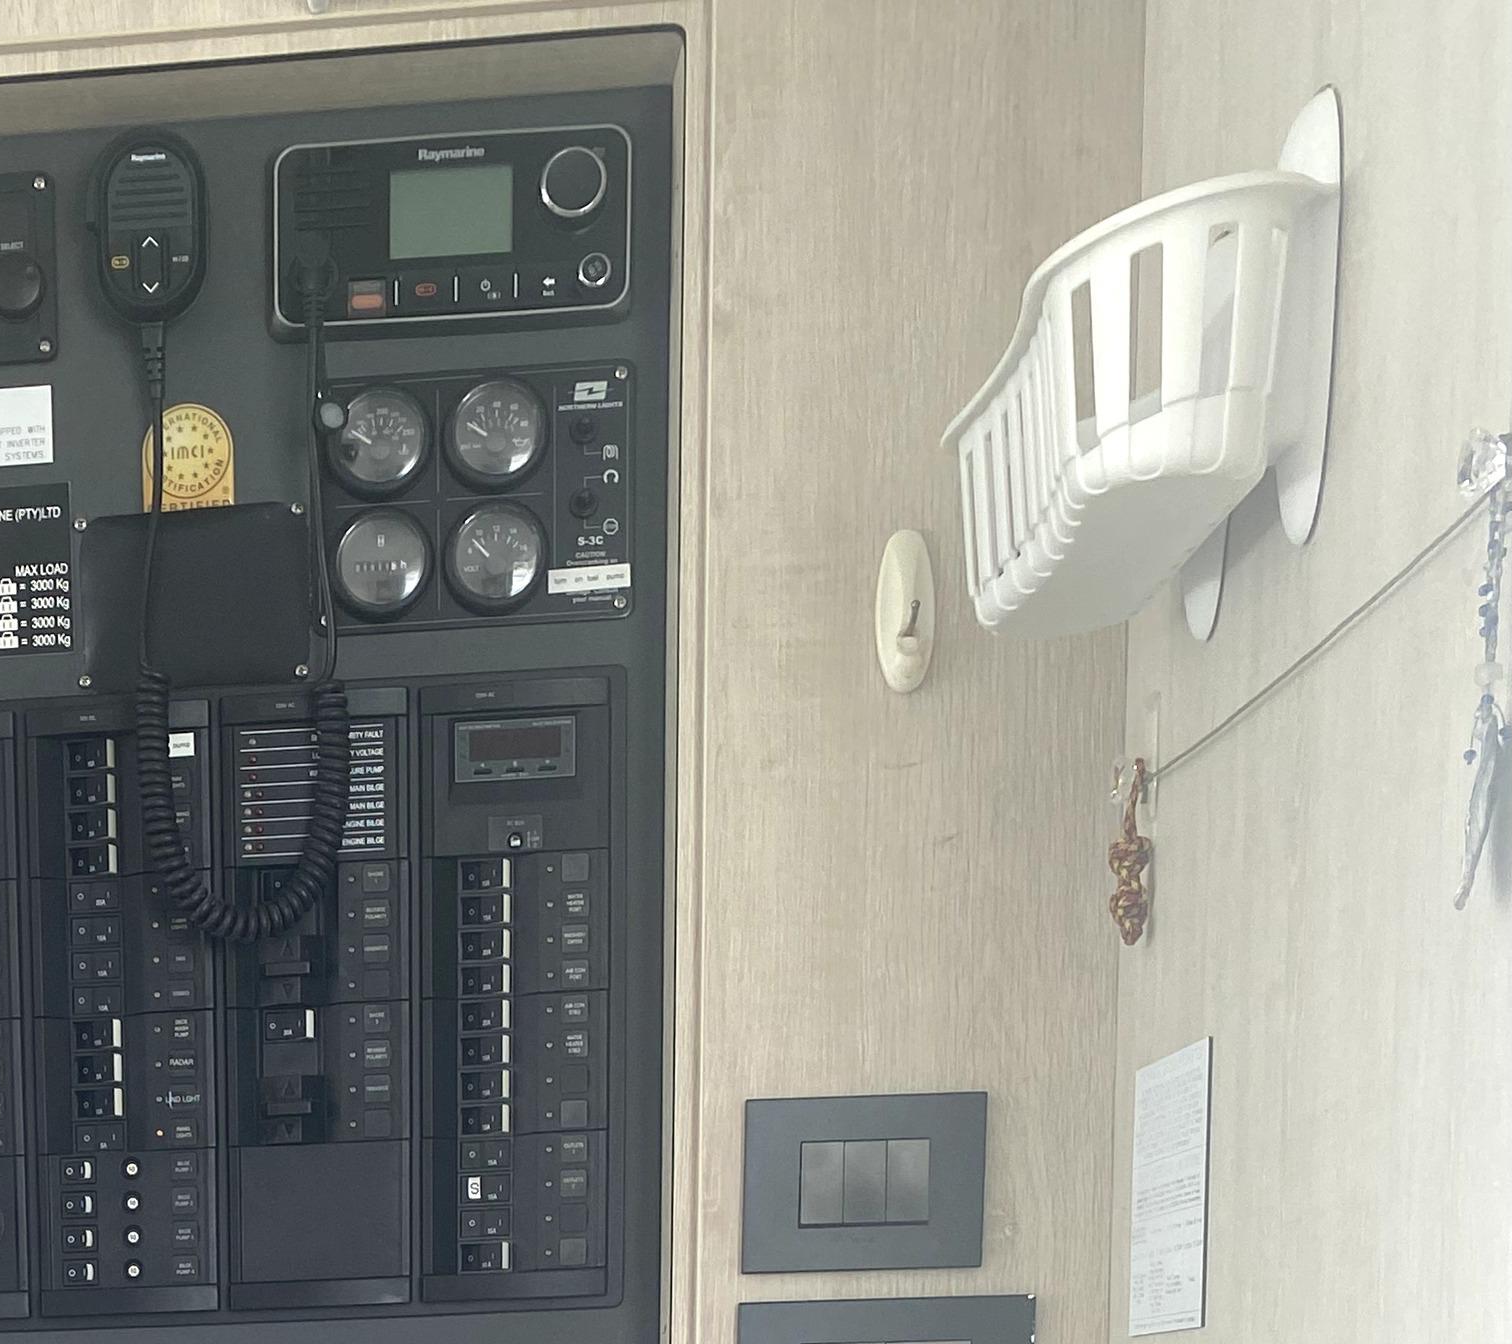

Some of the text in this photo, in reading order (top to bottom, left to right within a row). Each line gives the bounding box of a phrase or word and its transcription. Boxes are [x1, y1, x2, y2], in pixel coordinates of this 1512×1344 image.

[418, 146, 485, 162] Raymarine
[27, 425, 45, 434] WITH
[7, 438, 45, 448] INVERTER
[577, 535, 605, 546] S-3C
[15, 563, 68, 577] MAX LOAD
[30, 579, 54, 591] 3000
[56, 578, 69, 592] Kg
[31, 597, 54, 609] 3000
[56, 596, 70, 610] Kg
[31, 616, 55, 629] 3000
[57, 615, 70, 629] Kg
[32, 634, 55, 647] 3000
[57, 633, 71, 647] Kg
[364, 730, 383, 738] FAULT
[356, 747, 384, 756] VOLTAGE
[366, 765, 384, 773] PUMP
[350, 783, 384, 792] MAIN BILGE
[350, 801, 384, 810] MAIN BILGE
[367, 818, 384, 827] BILGE
[342, 836, 384, 846] ENGINE BILGE
[169, 1058, 194, 1066] RADAR
[470, 1182, 480, 1195] S
